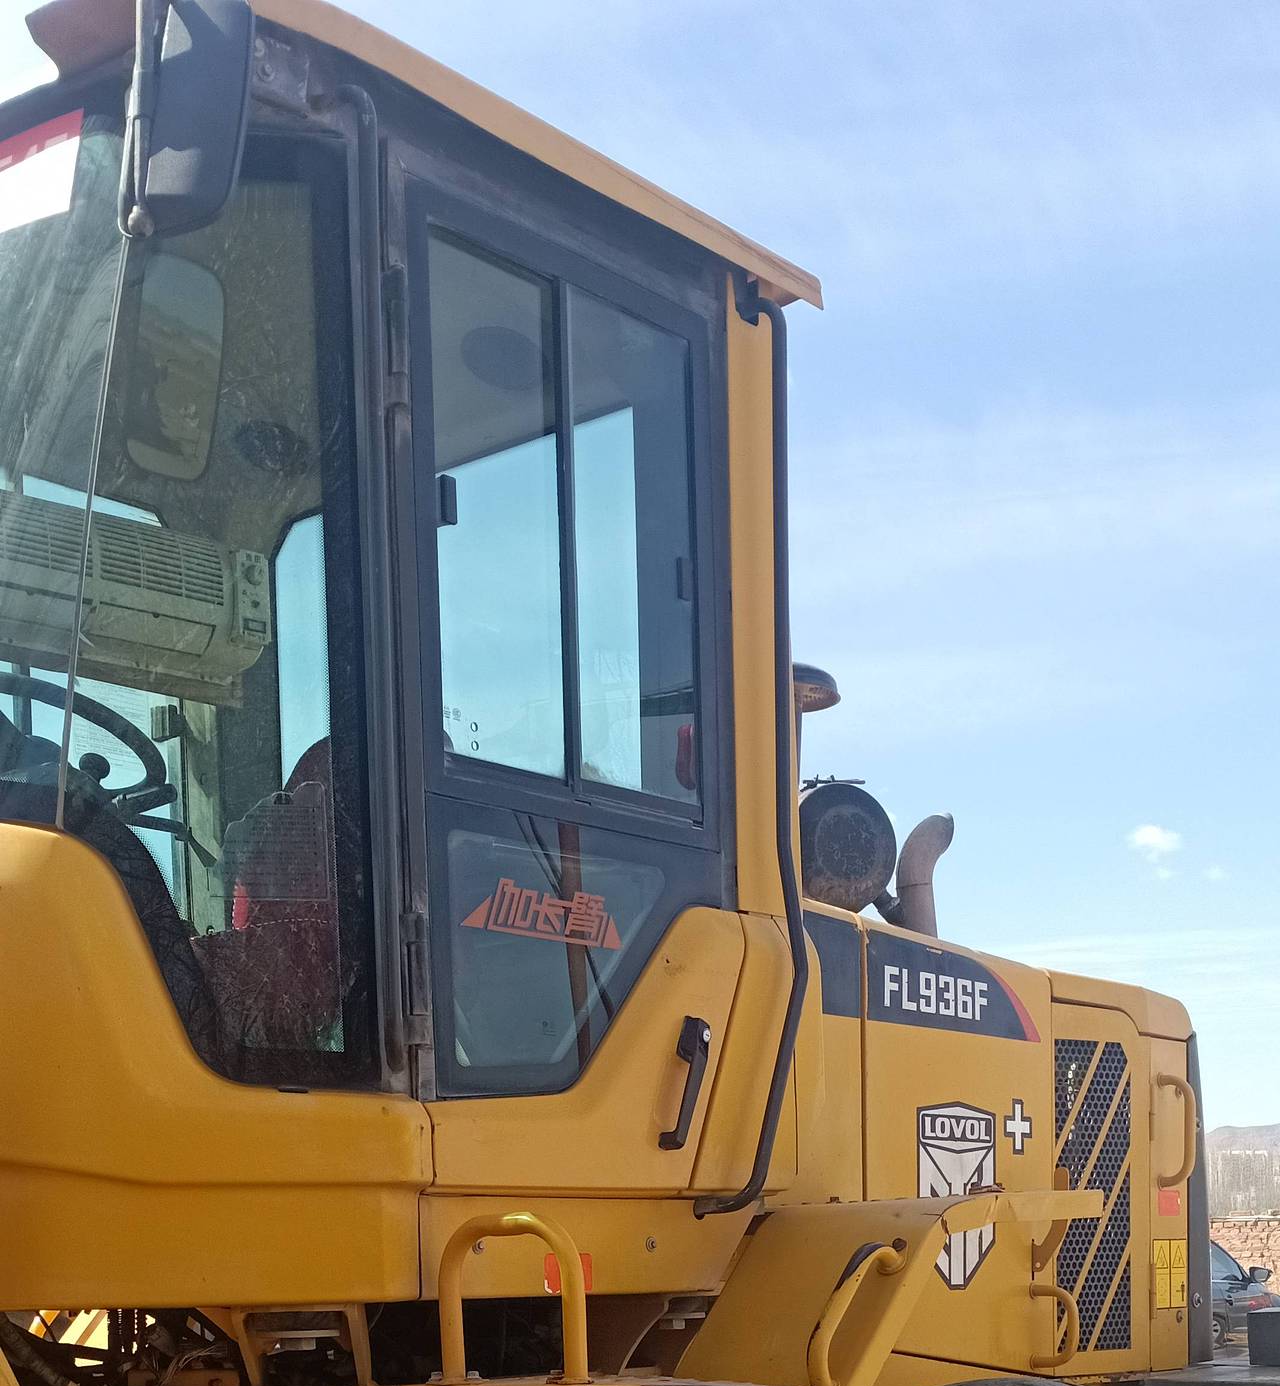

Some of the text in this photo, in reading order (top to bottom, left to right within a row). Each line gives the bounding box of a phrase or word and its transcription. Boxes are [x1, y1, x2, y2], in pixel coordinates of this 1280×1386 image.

[487, 878, 608, 947] 加长臂
[883, 965, 988, 1021] FL936F
[924, 1116, 990, 1141] LOVOL
